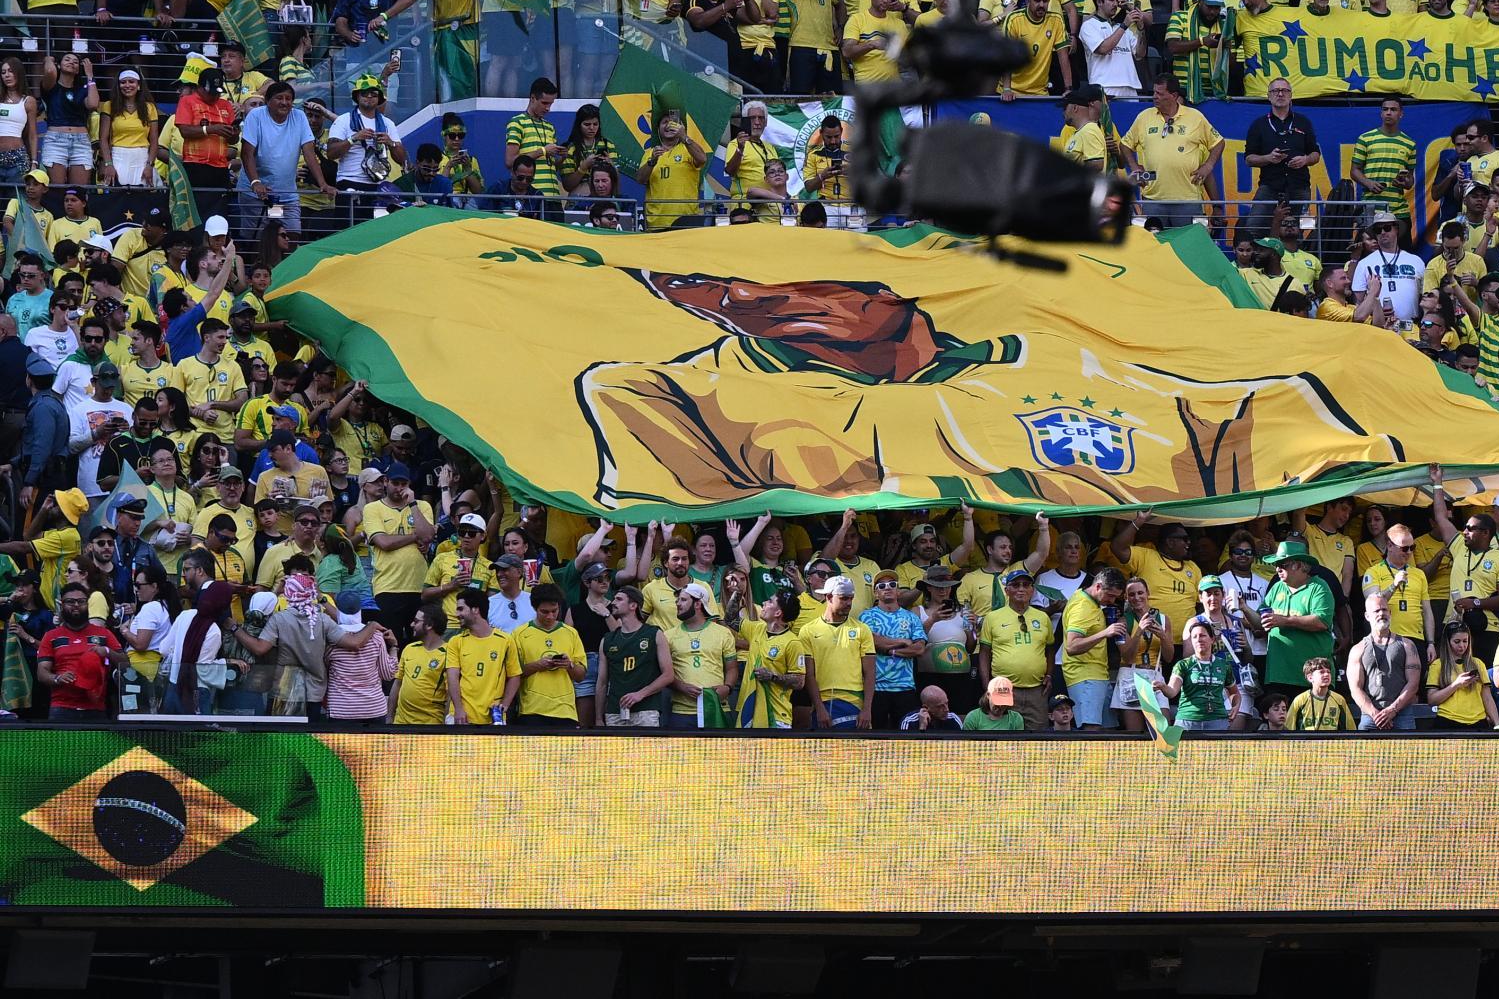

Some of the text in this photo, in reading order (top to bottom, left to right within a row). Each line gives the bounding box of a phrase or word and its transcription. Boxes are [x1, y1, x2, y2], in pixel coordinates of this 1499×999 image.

[1032, 43, 1040, 57] 9
[1258, 36, 1406, 81] RUMO
[1409, 61, 1441, 82] AO
[796, 113, 824, 153] MOCIDADE
[660, 166, 670, 180] 10
[1062, 426, 1103, 440] CBF
[1172, 580, 1186, 594] 10
[1014, 631, 1032, 645] 20
[623, 655, 637, 672] 10
[693, 655, 701, 669] 8
[411, 665, 422, 679] 9
[476, 662, 486, 677] 9
